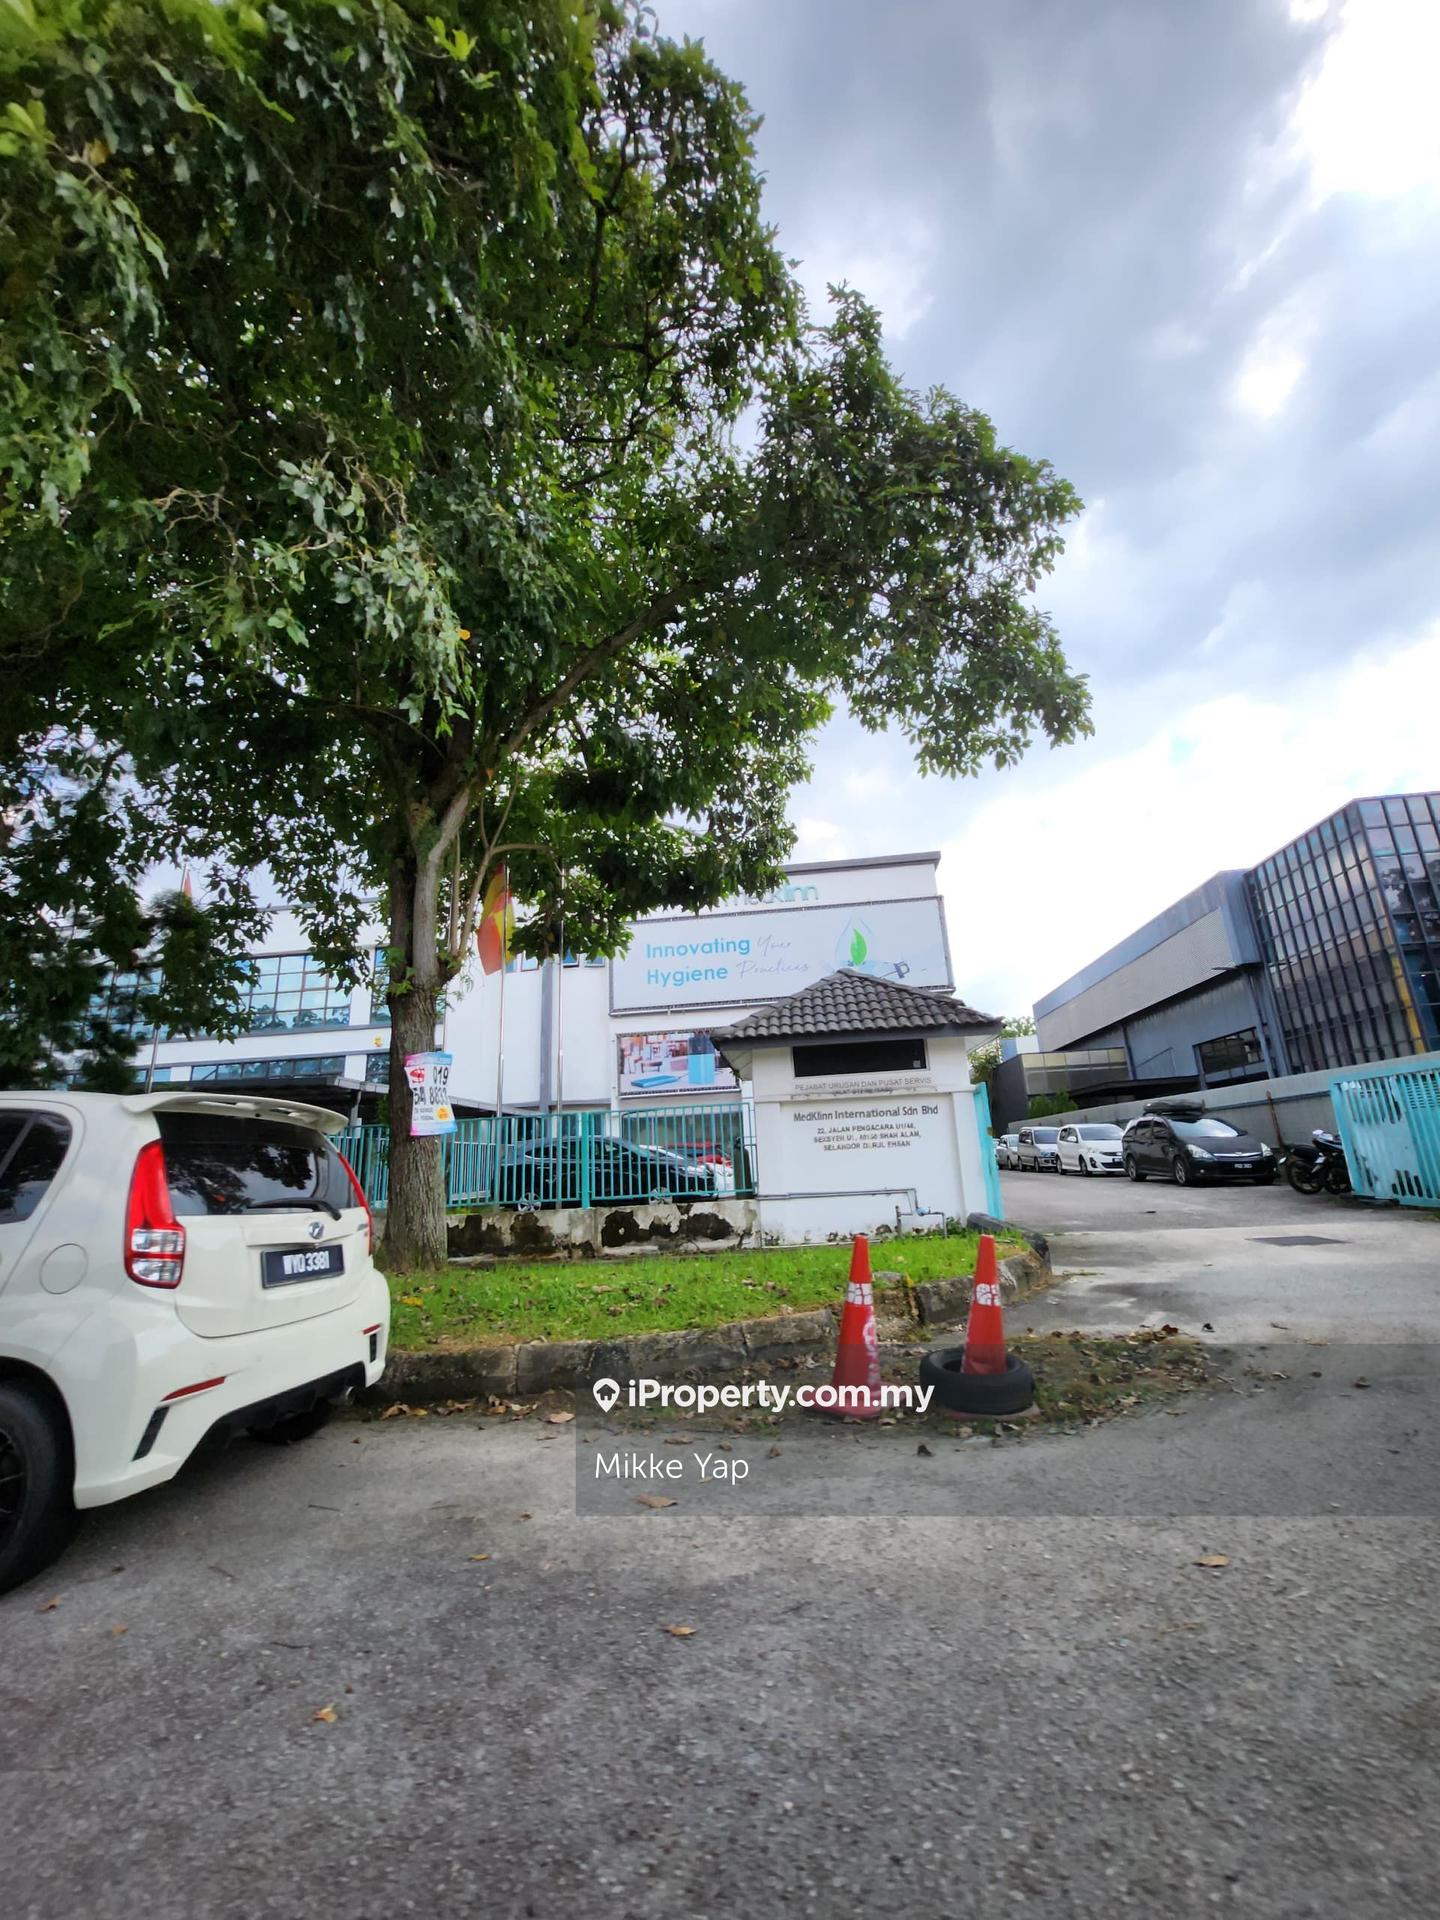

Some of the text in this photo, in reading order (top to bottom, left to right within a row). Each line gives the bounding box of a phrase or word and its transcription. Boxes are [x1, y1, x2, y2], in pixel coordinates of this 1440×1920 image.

[646, 937, 751, 959] Innovating
[646, 965, 729, 988] Hygiene
[861, 1080, 878, 1088] DAN
[879, 1079, 903, 1087] PUSAT
[793, 1105, 938, 1122] MedKlinn International Sdn Bhd
[829, 1126, 850, 1134] JALAN
